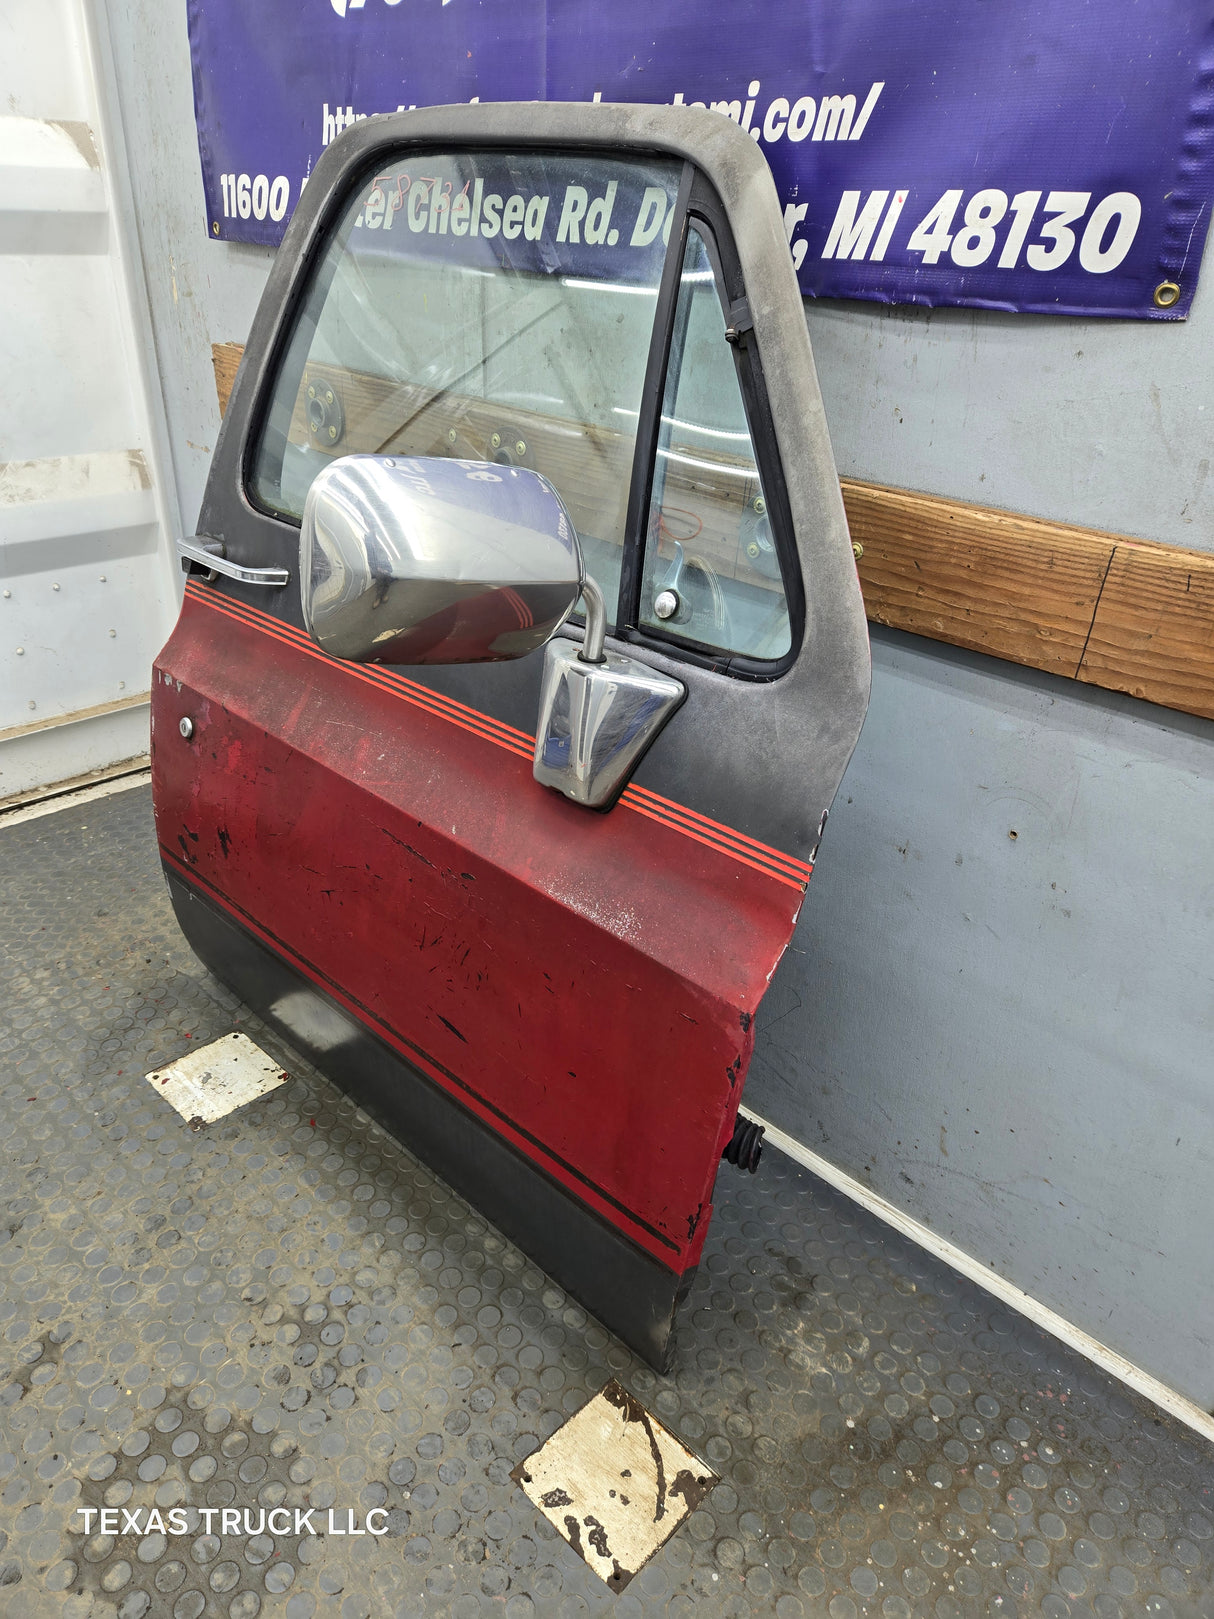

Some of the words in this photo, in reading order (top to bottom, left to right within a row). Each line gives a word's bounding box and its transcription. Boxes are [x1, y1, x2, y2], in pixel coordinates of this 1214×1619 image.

[220, 173, 290, 222] 11600
[407, 177, 550, 241] Chelsea
[556, 180, 620, 246] Rd.
[821, 190, 909, 262] MI
[906, 188, 1142, 274] 48130
